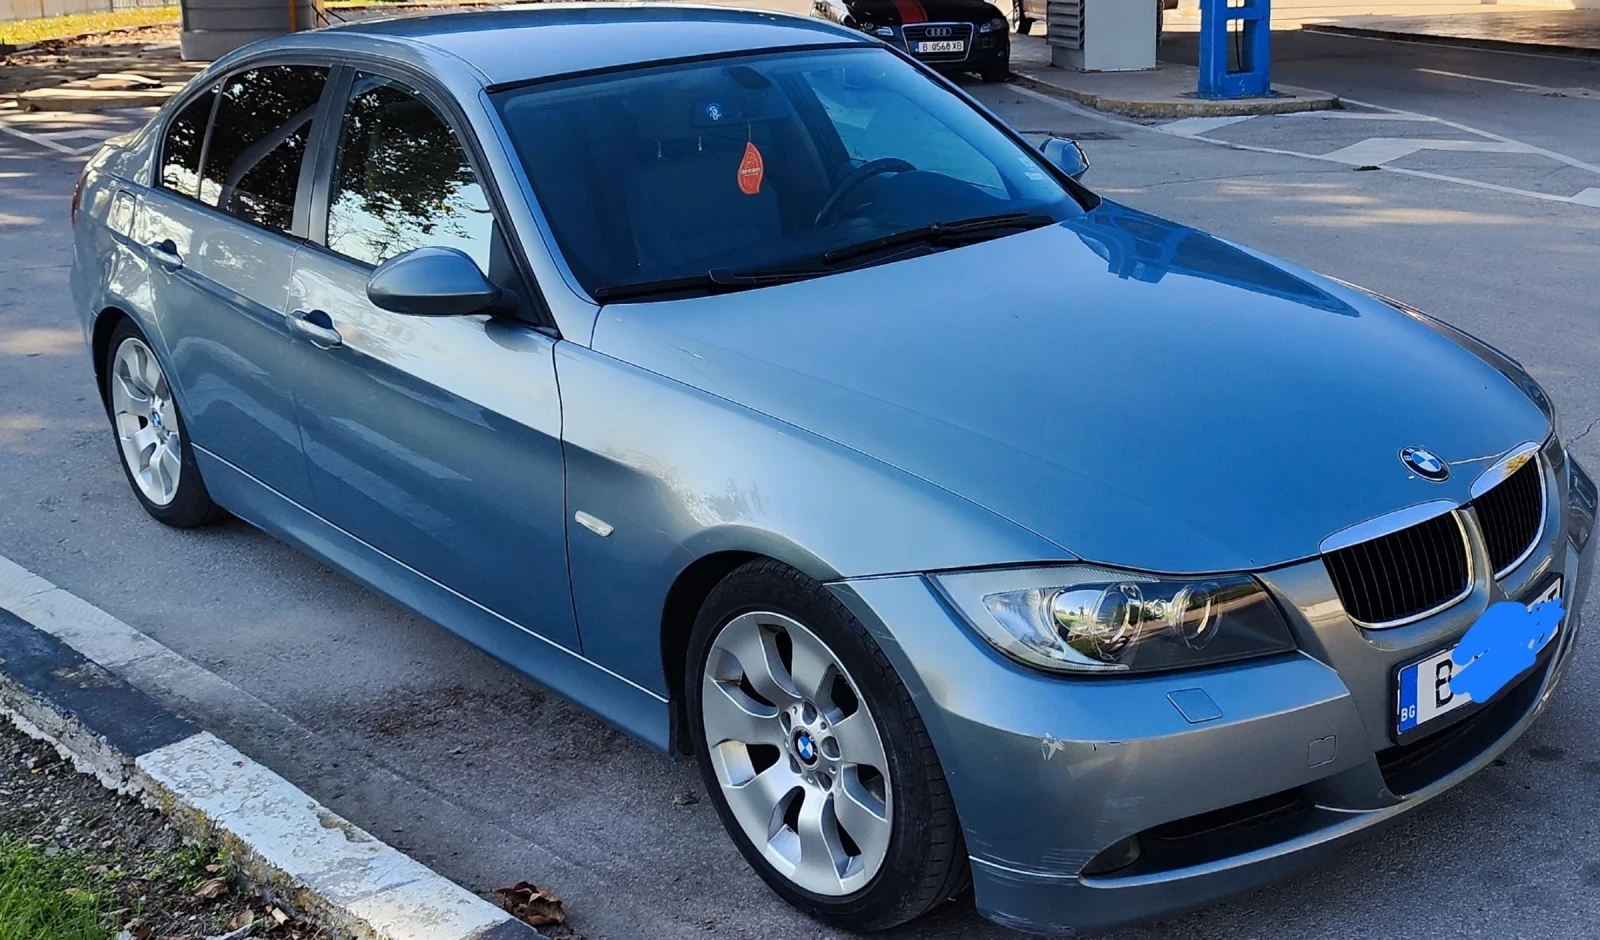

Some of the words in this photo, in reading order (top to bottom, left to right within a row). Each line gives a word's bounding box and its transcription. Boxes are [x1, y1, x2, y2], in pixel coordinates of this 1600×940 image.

[931, 42, 951, 50] 0568
[952, 42, 963, 50] XB
[1435, 658, 1454, 709] B
[1401, 705, 1416, 722] BG
